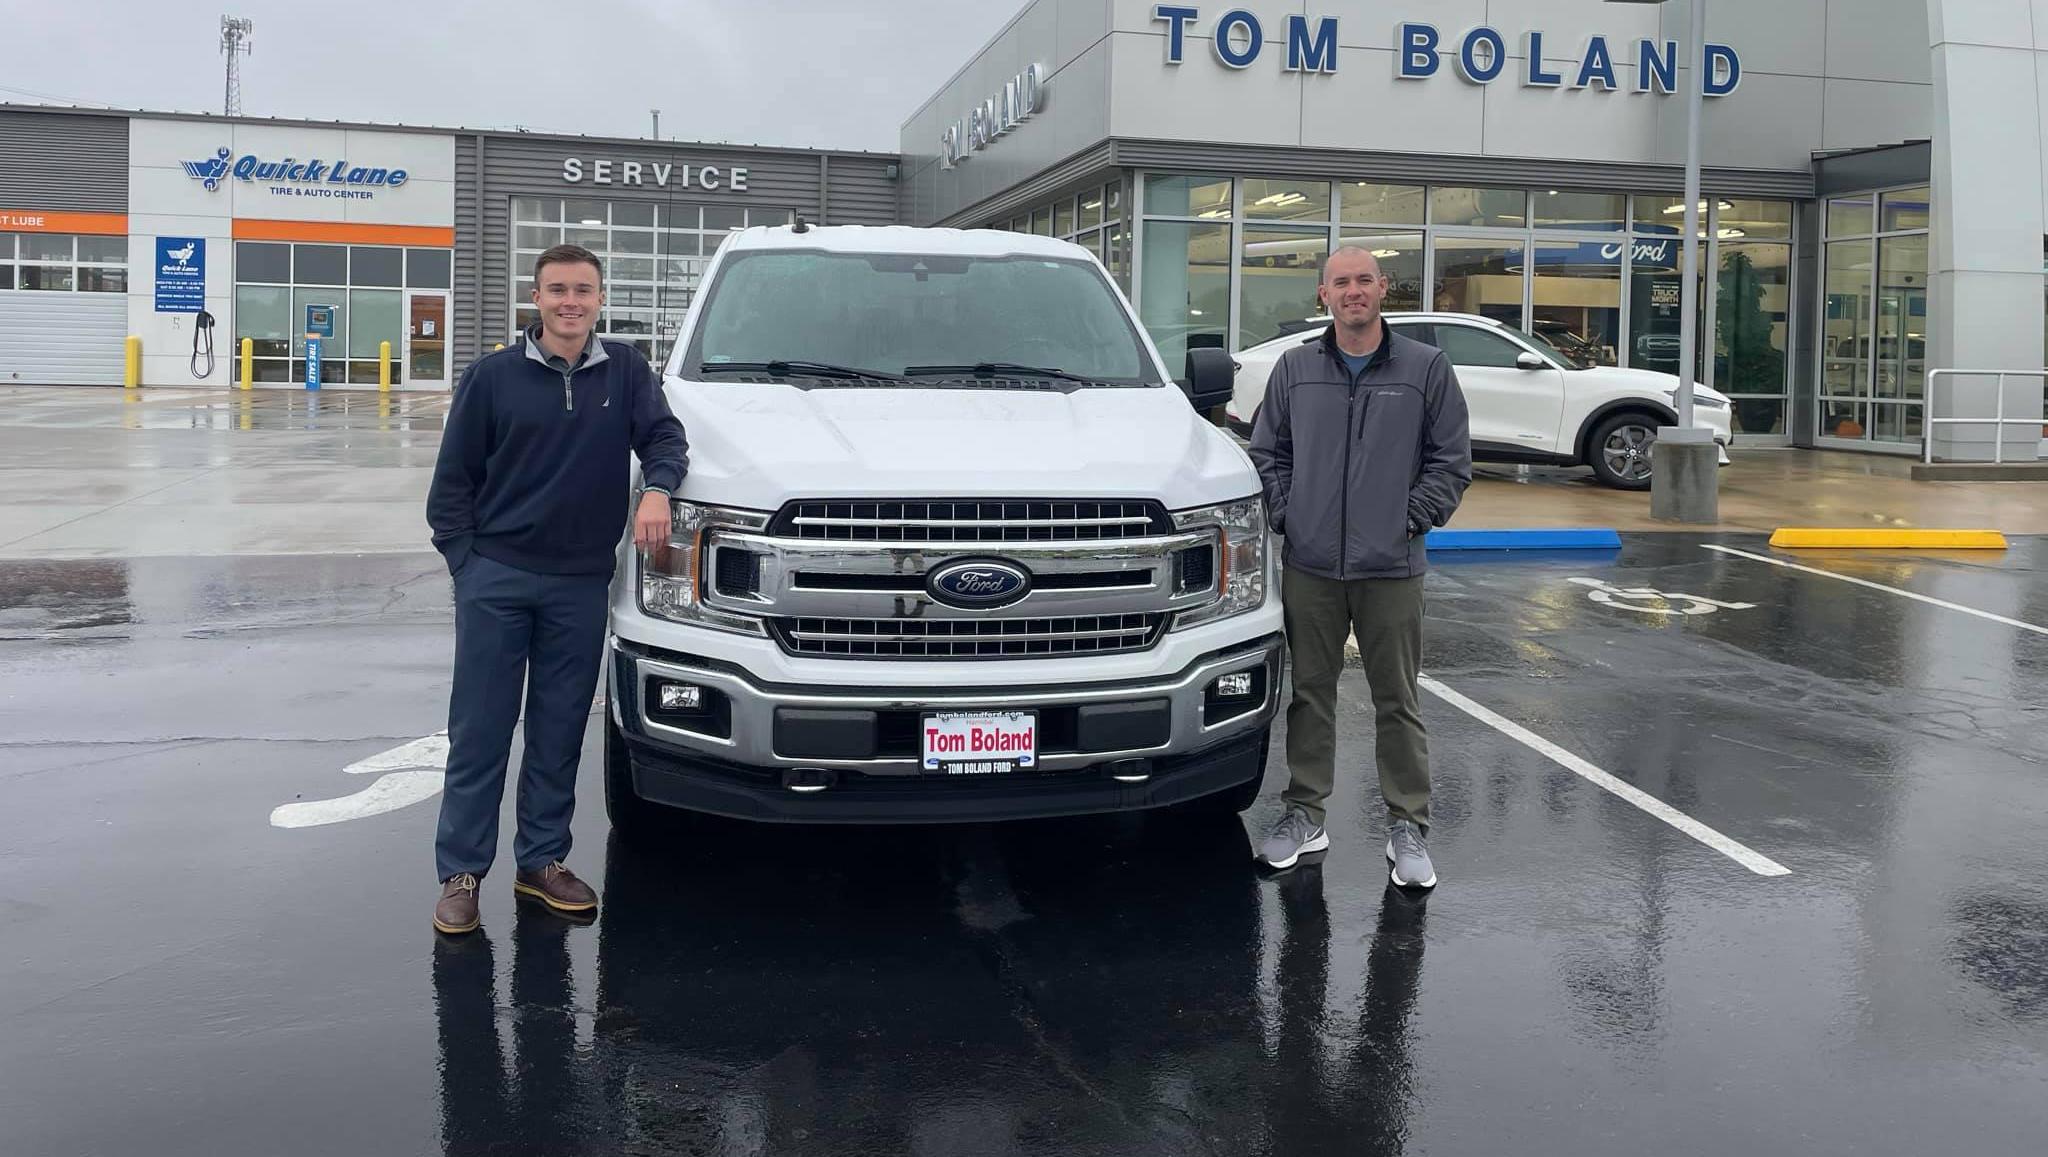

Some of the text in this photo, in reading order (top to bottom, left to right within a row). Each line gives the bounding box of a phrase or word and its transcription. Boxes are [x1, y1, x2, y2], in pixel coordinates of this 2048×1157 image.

[1153, 5, 1742, 98] TOM BOLAND
[970, 62, 1043, 151] BOLAND
[232, 155, 409, 187] Quick Lane
[563, 157, 748, 191] SERVICE
[270, 187, 373, 199] TIRE & AUTO CENTER
[12, 216, 45, 226] LUBE
[308, 343, 317, 360] TIRE
[956, 571, 1004, 593] Ford
[926, 727, 1033, 752] Tom Boland
[947, 762, 1011, 774] TOM BOLAND FORD
